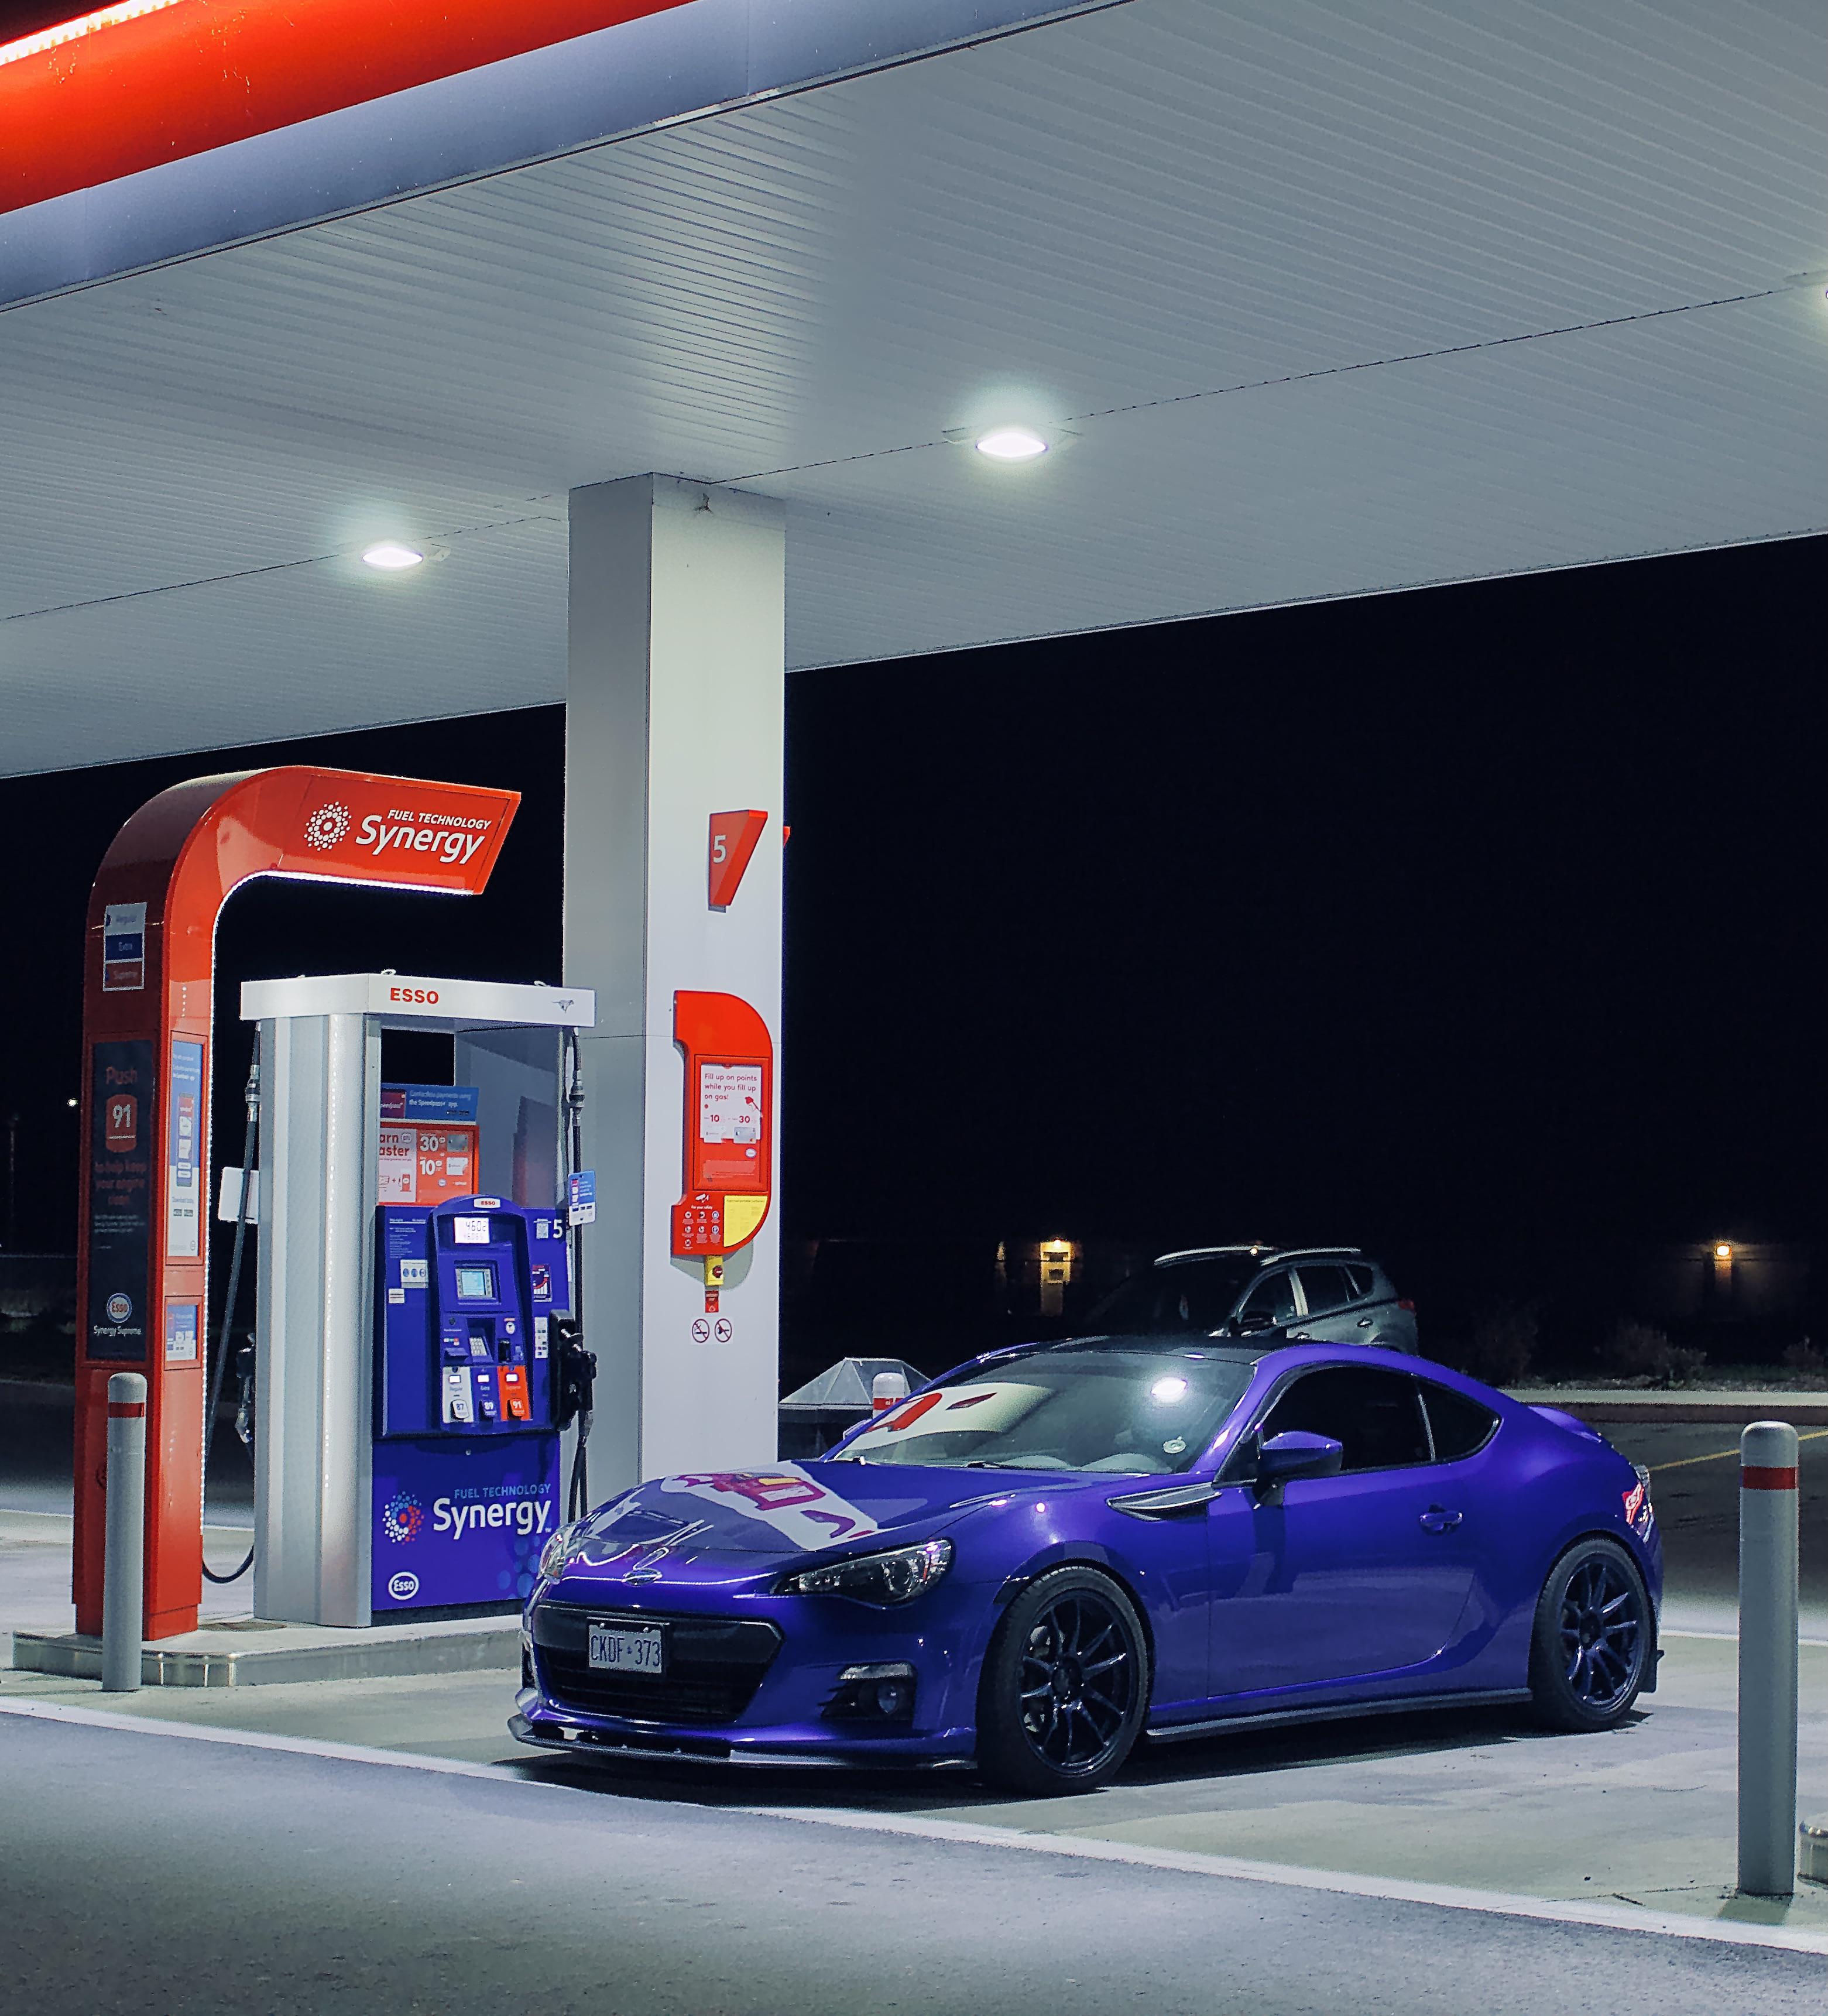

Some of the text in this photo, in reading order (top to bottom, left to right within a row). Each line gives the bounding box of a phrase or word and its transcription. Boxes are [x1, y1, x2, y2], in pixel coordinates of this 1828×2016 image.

[387, 809, 492, 830] FUEL TECHNOLOGY
[355, 815, 485, 865] Synergy
[713, 835, 727, 863] 5
[390, 988, 439, 1004] ESSO
[105, 1066, 138, 1085] Push
[112, 1103, 132, 1128] 91
[710, 1115, 720, 1123] 10
[739, 1115, 750, 1123] 30
[379, 1134, 399, 1143] arn
[420, 1136, 438, 1152] 30
[379, 1145, 410, 1156] aster
[420, 1160, 435, 1175] 10
[553, 1219, 563, 1239] 5
[94, 1325, 117, 1337] Synergy
[454, 1483, 551, 1499] FUEL TECHNOLOGY
[433, 1497, 551, 1540] Synergy
[393, 1579, 414, 1592] Esso
[591, 1635, 661, 1667] CKDF 373
